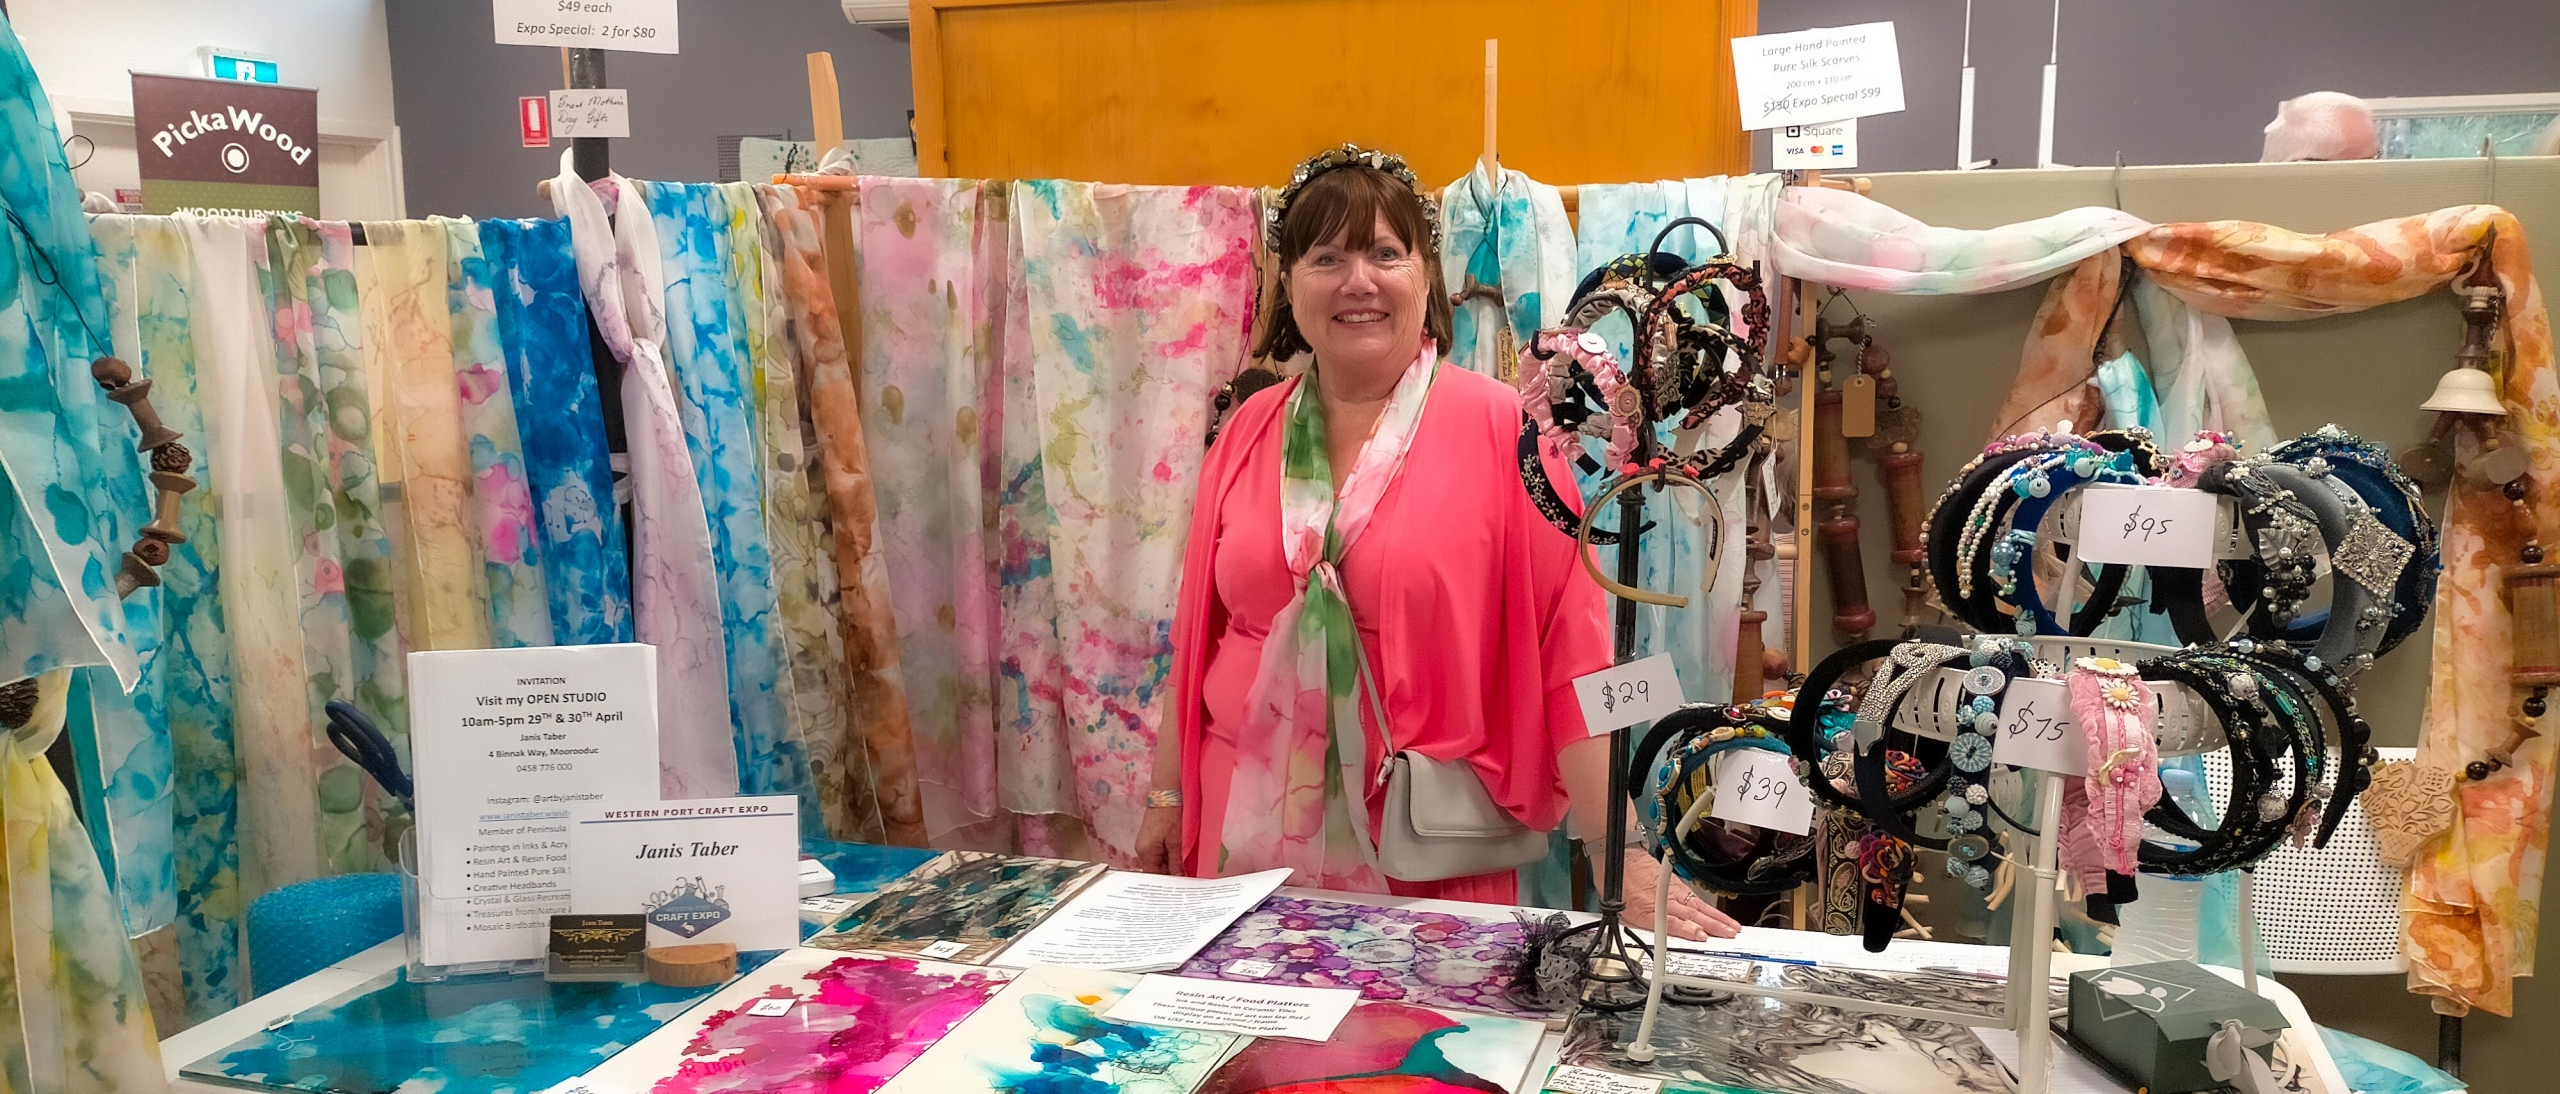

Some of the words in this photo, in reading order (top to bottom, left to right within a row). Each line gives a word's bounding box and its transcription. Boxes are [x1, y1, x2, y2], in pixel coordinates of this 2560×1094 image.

[557, 0, 581, 13] $49
[584, 1, 612, 13] each
[517, 23, 546, 35] Expo
[549, 23, 595, 36] Special:
[601, 27, 610, 37] 2
[611, 26, 630, 39] for
[633, 26, 656, 39] $80
[1762, 45, 1792, 57] Large
[1795, 40, 1823, 52] Hand
[1825, 34, 1866, 48] Painted
[1773, 63, 1797, 73] Pure
[1800, 59, 1818, 70] Silk
[1821, 54, 1860, 67] Scarves
[1786, 80, 1801, 89] 200
[1803, 79, 1815, 87] cm
[1793, 97, 1818, 109] Expo
[1821, 90, 1858, 106] Special
[1861, 87, 1881, 99] $99
[558, 109, 578, 135] Day
[1803, 126, 1843, 138] Square
[1786, 147, 1804, 155] VISA
[176, 206, 303, 220] WOODTUR
[2123, 505, 2173, 542] $95
[517, 677, 566, 686] INVITATION
[476, 695, 502, 706] Visit
[506, 697, 524, 707] my
[526, 693, 559, 704] OPEN
[562, 692, 607, 703] STUDIO
[1602, 680, 1649, 714] $29
[461, 715, 525, 728] 10am-5pm
[528, 712, 552, 725] 29TH
[555, 713, 565, 724] &
[568, 711, 593, 723] 30TH
[595, 711, 623, 723] April
[2009, 701, 2070, 741] $75
[520, 733, 541, 742] Janis
[543, 733, 566, 741] Taber
[496, 750, 525, 758] Binnak
[527, 749, 548, 758] Way,
[550, 747, 599, 756] Moorooduc
[557, 763, 573, 771] 000
[1737, 765, 1788, 809] $39
[487, 796, 530, 806] Instagram:
[533, 793, 604, 804] @artbyjanistaber
[605, 810, 659, 819] WESTERN
[664, 808, 694, 817] PORT
[698, 806, 735, 815] CRAFT
[739, 805, 769, 813] EXPO
[478, 827, 513, 836] Member
[516, 826, 526, 834] of
[527, 825, 567, 834] Peninsula
[473, 844, 511, 853] Paintings
[522, 842, 539, 850] Inks
[635, 843, 683, 860] Janis
[690, 841, 739, 858] Taber
[473, 858, 495, 866] Resin
[498, 856, 511, 864] Art
[522, 855, 544, 863] Resin
[546, 854, 567, 862] Food
[473, 871, 495, 879] Hand
[498, 869, 529, 878] Painted
[531, 868, 550, 876] Pure
[552, 866, 567, 874] Silk
[473, 884, 508, 892] Creative
[510, 881, 557, 890] Headbands
[473, 897, 502, 906] Crystal
[513, 895, 535, 903] Glass
[473, 909, 513, 919] Treasures
[515, 908, 535, 916] from
[538, 906, 566, 915] Nature
[656, 912, 689, 922] CRAFT
[692, 911, 720, 920] EXPO
[473, 923, 503, 932] Mosaic
[505, 920, 545, 930] Birdbaths
[1267, 999, 1310, 1008] Platters
